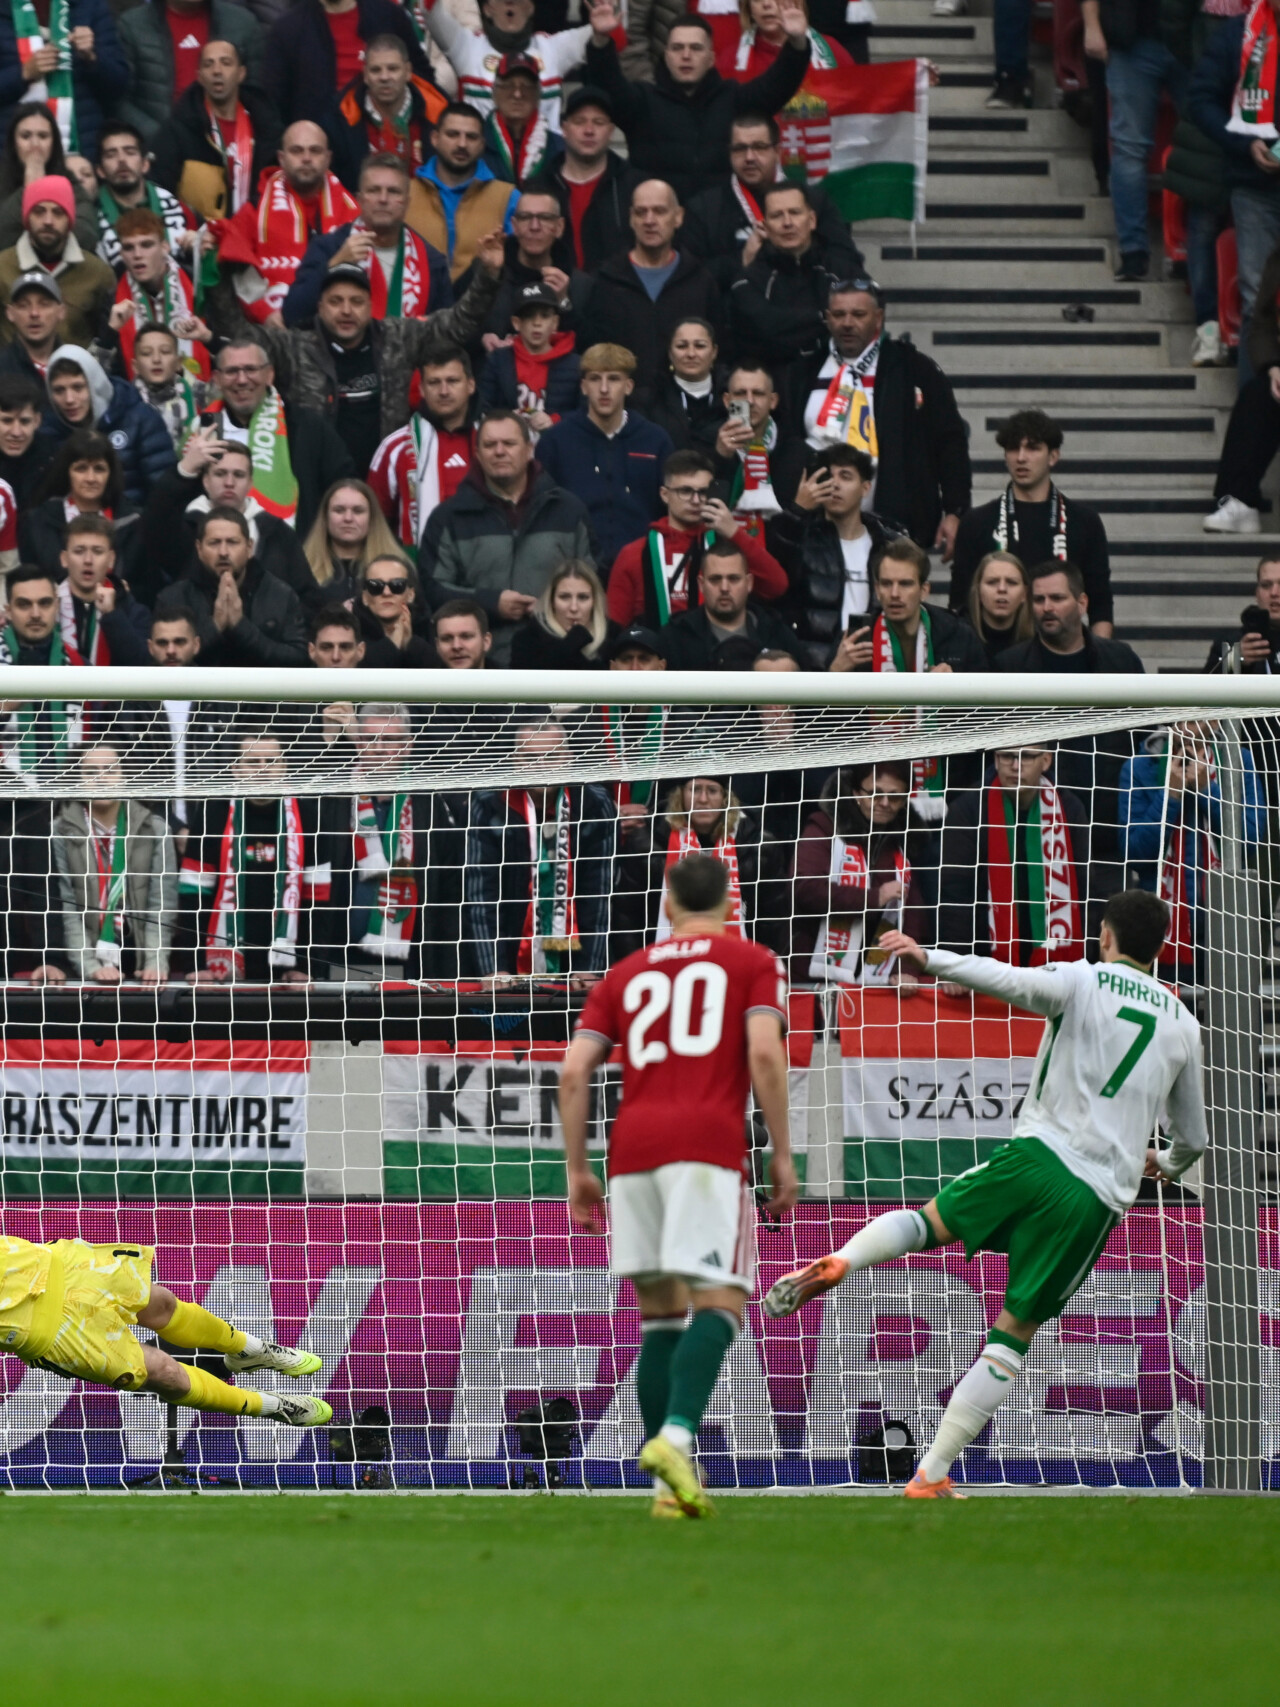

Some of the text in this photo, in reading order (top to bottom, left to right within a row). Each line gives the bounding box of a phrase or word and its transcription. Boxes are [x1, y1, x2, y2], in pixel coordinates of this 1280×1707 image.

[623, 961, 728, 1070] 20
[1097, 970, 1182, 1020] PARROTT
[1099, 1004, 1158, 1099] 7
